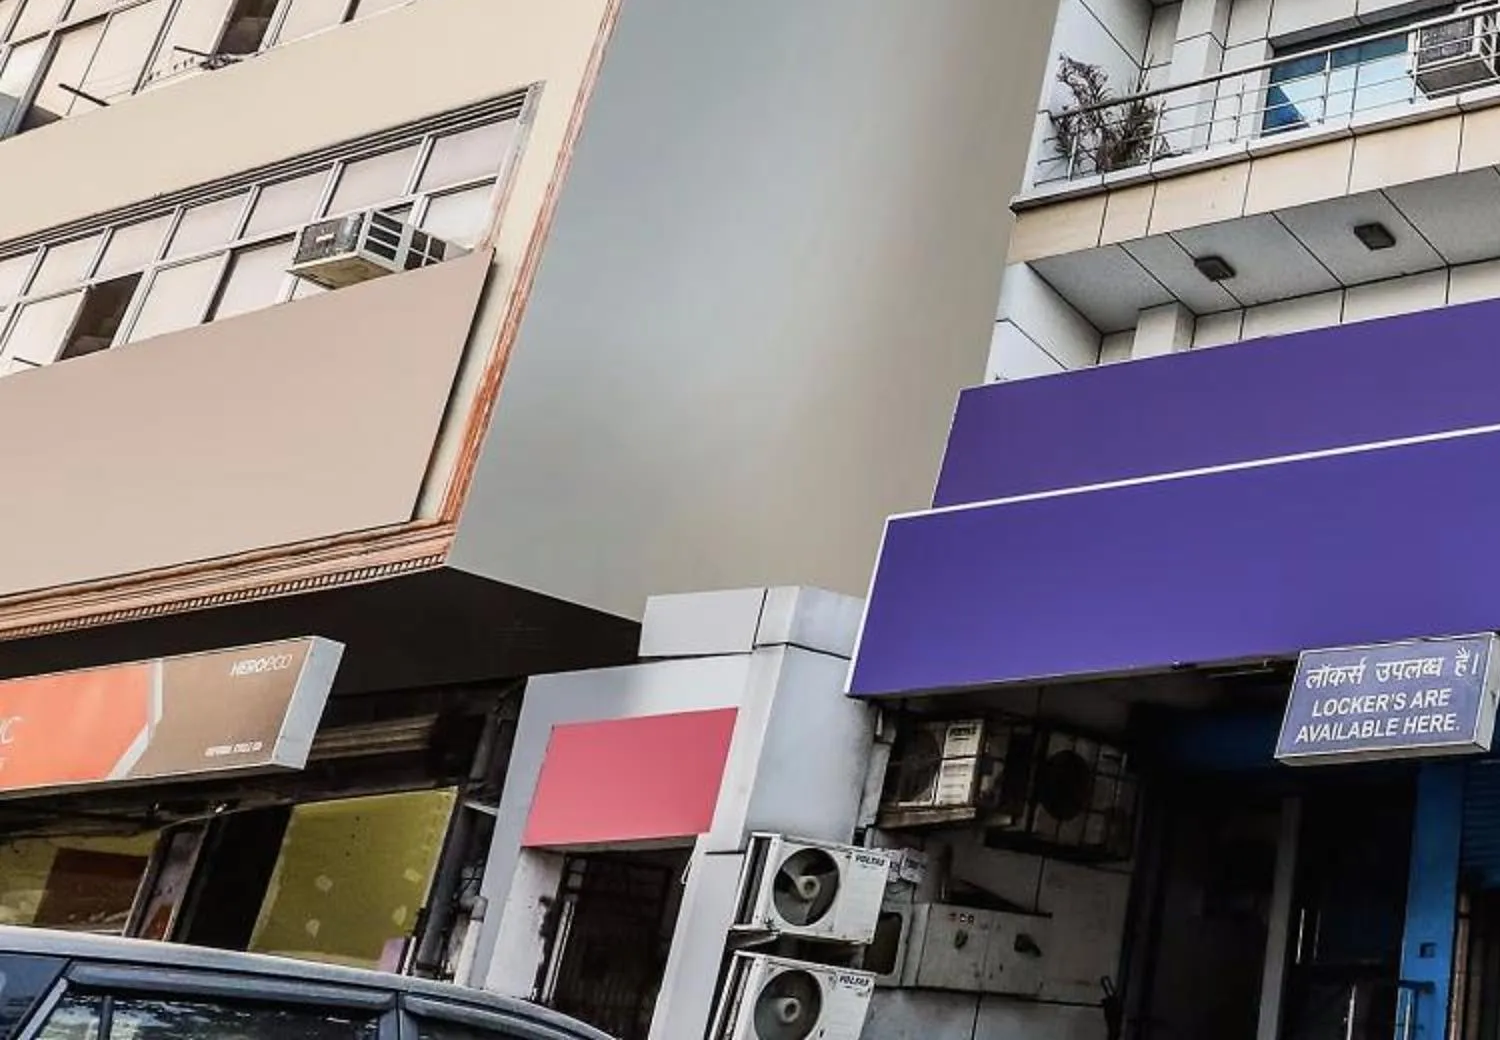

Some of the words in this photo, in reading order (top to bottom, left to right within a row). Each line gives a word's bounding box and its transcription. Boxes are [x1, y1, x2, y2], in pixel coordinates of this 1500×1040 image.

[1305, 655, 1367, 689] लॉकर्स
[1375, 656, 1445, 683] उपलब्ध
[1312, 692, 1407, 717] LOCKER'S
[1410, 688, 1452, 708] ARE
[1295, 718, 1399, 743] AVAILABLE
[1402, 713, 1461, 735] HERE.
